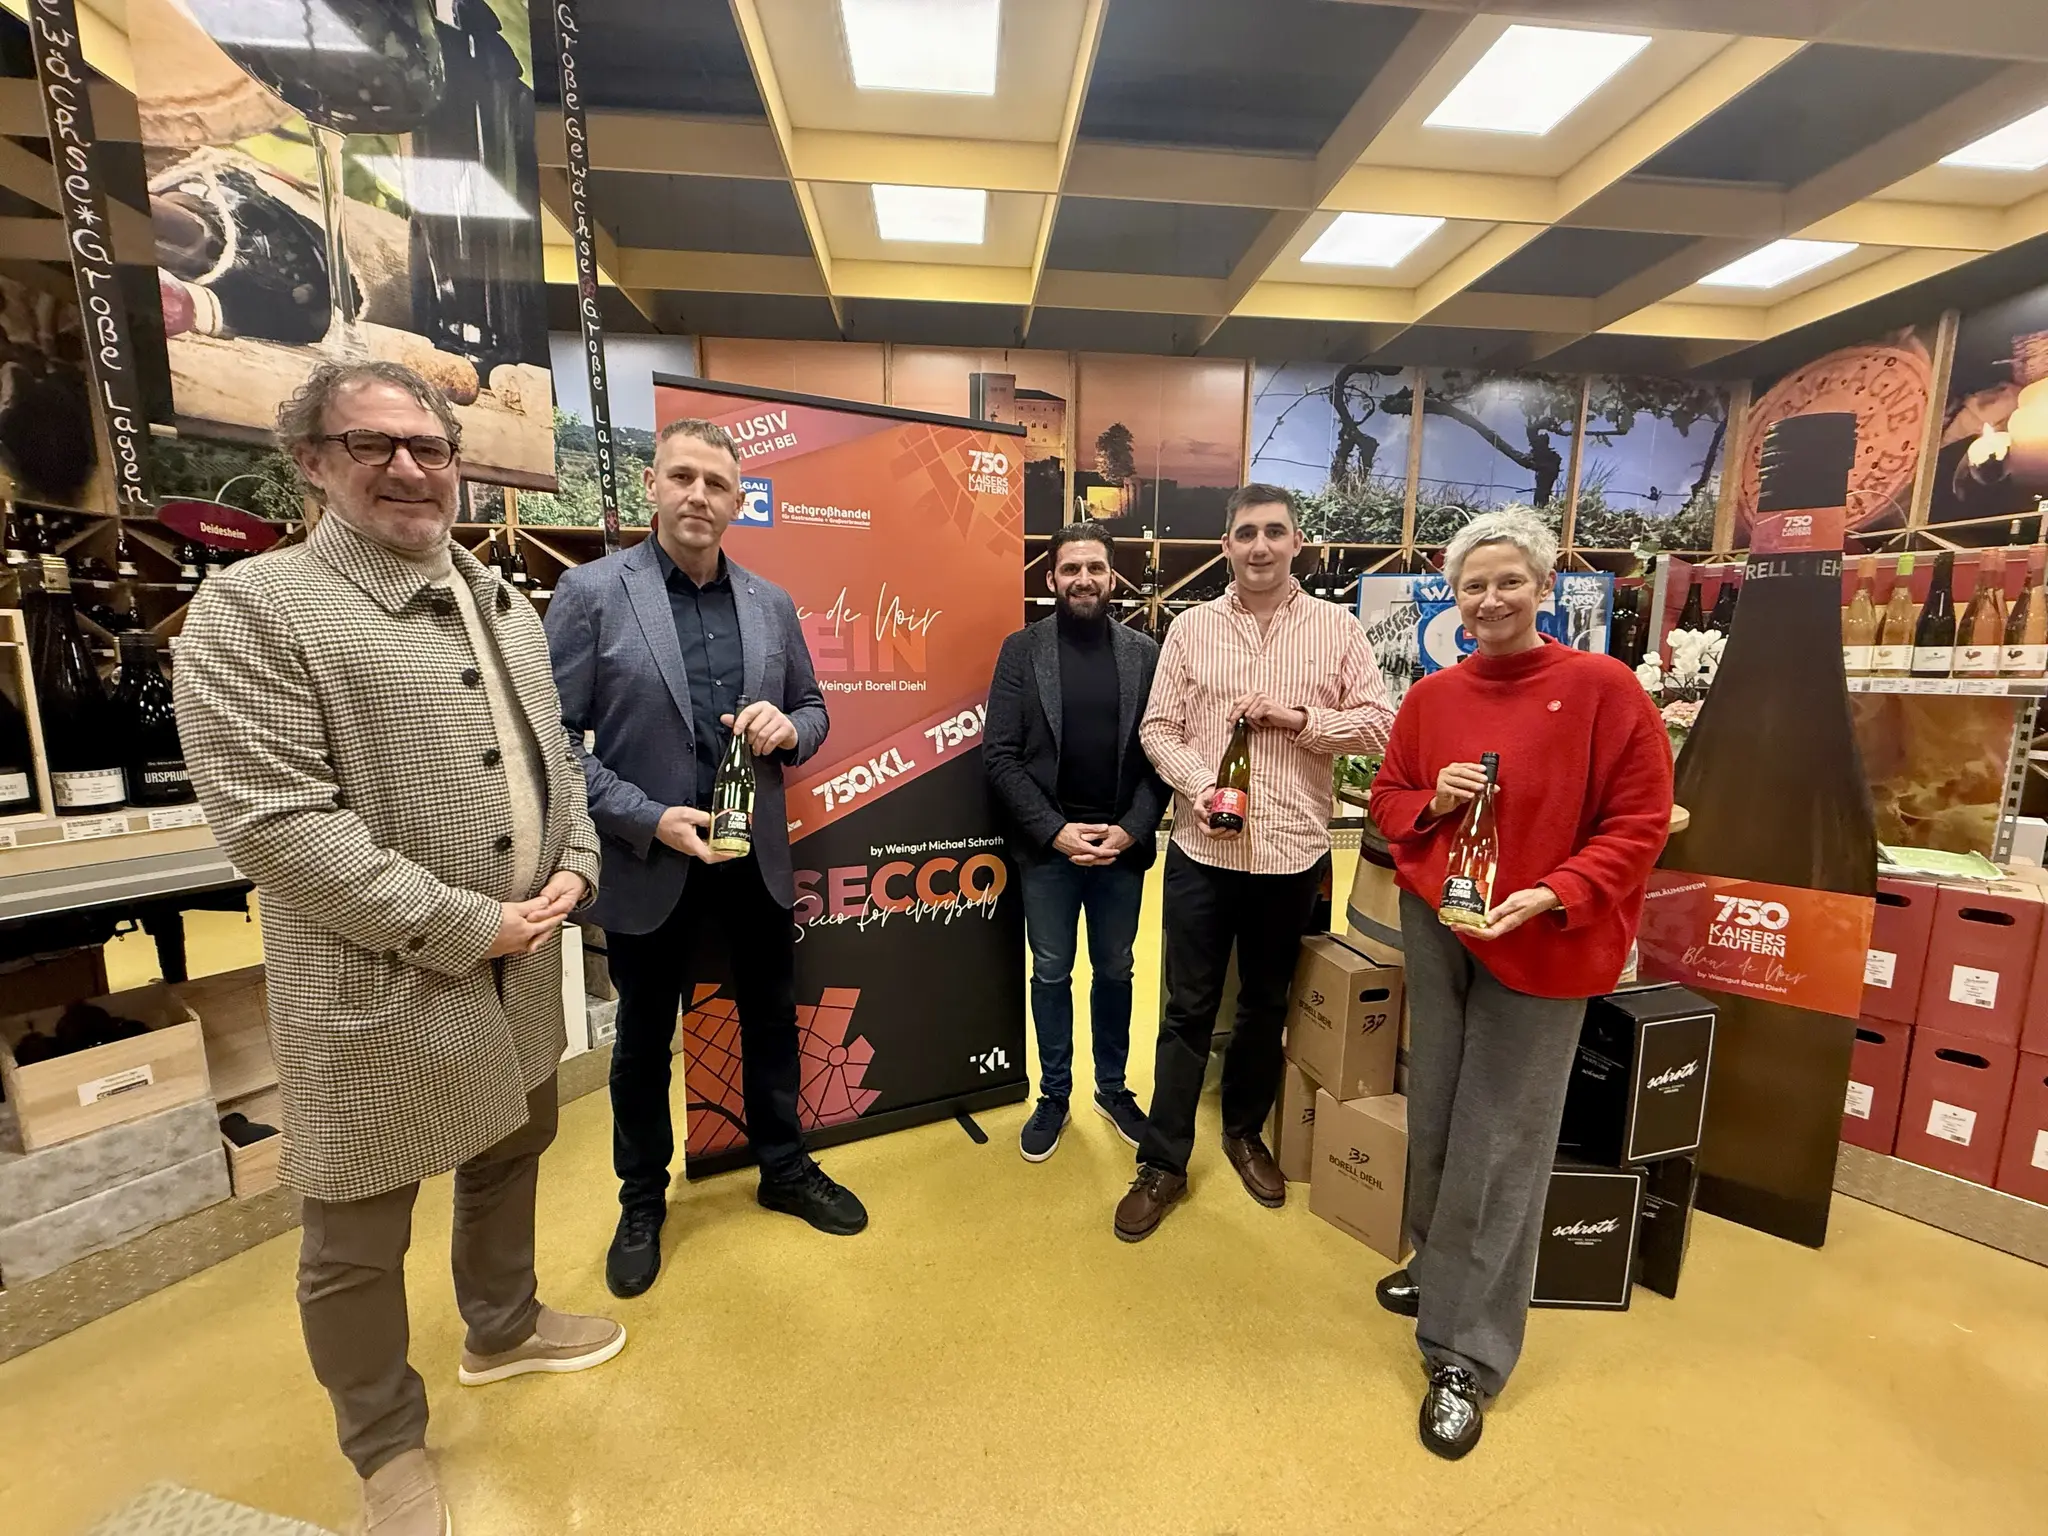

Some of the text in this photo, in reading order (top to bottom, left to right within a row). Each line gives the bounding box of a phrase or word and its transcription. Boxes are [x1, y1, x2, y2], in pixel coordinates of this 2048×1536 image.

[721, 410, 788, 443] LUSIV
[104, 380, 155, 507] Lagen
[774, 433, 798, 450] BEI
[595, 404, 616, 508] Lagen
[968, 450, 1009, 475] 750
[968, 473, 1009, 487] KAISERS
[968, 482, 1009, 496] LAUTERN
[781, 501, 871, 520] Fachgroßhandel
[1783, 515, 1813, 528] 750
[199, 521, 247, 540] Deidesheim
[1745, 560, 1793, 581] RELL
[826, 581, 943, 642] de Noir
[801, 612, 927, 672] EIN
[818, 680, 927, 694] Weingut Borell Diehl
[144, 770, 190, 784] URSPRUN
[811, 747, 916, 813] 750KL
[870, 836, 1004, 858] by Weingut Michael Schroth
[793, 853, 1008, 925] SECCO
[1451, 878, 1473, 890] 750
[1645, 882, 1707, 899] UBILÄUMSWEIN
[857, 893, 897, 933] for
[1713, 894, 1790, 930] 750
[1707, 934, 1786, 958] LAUTERN
[1709, 923, 1787, 947] KAISERS
[1697, 970, 1787, 993] by Weingut Borell Diehl
[1646, 1059, 1699, 1089] schroth
[1329, 1153, 1359, 1178] BORELL
[1360, 1170, 1384, 1191] DIEHL
[1551, 1217, 1620, 1237] schroth
